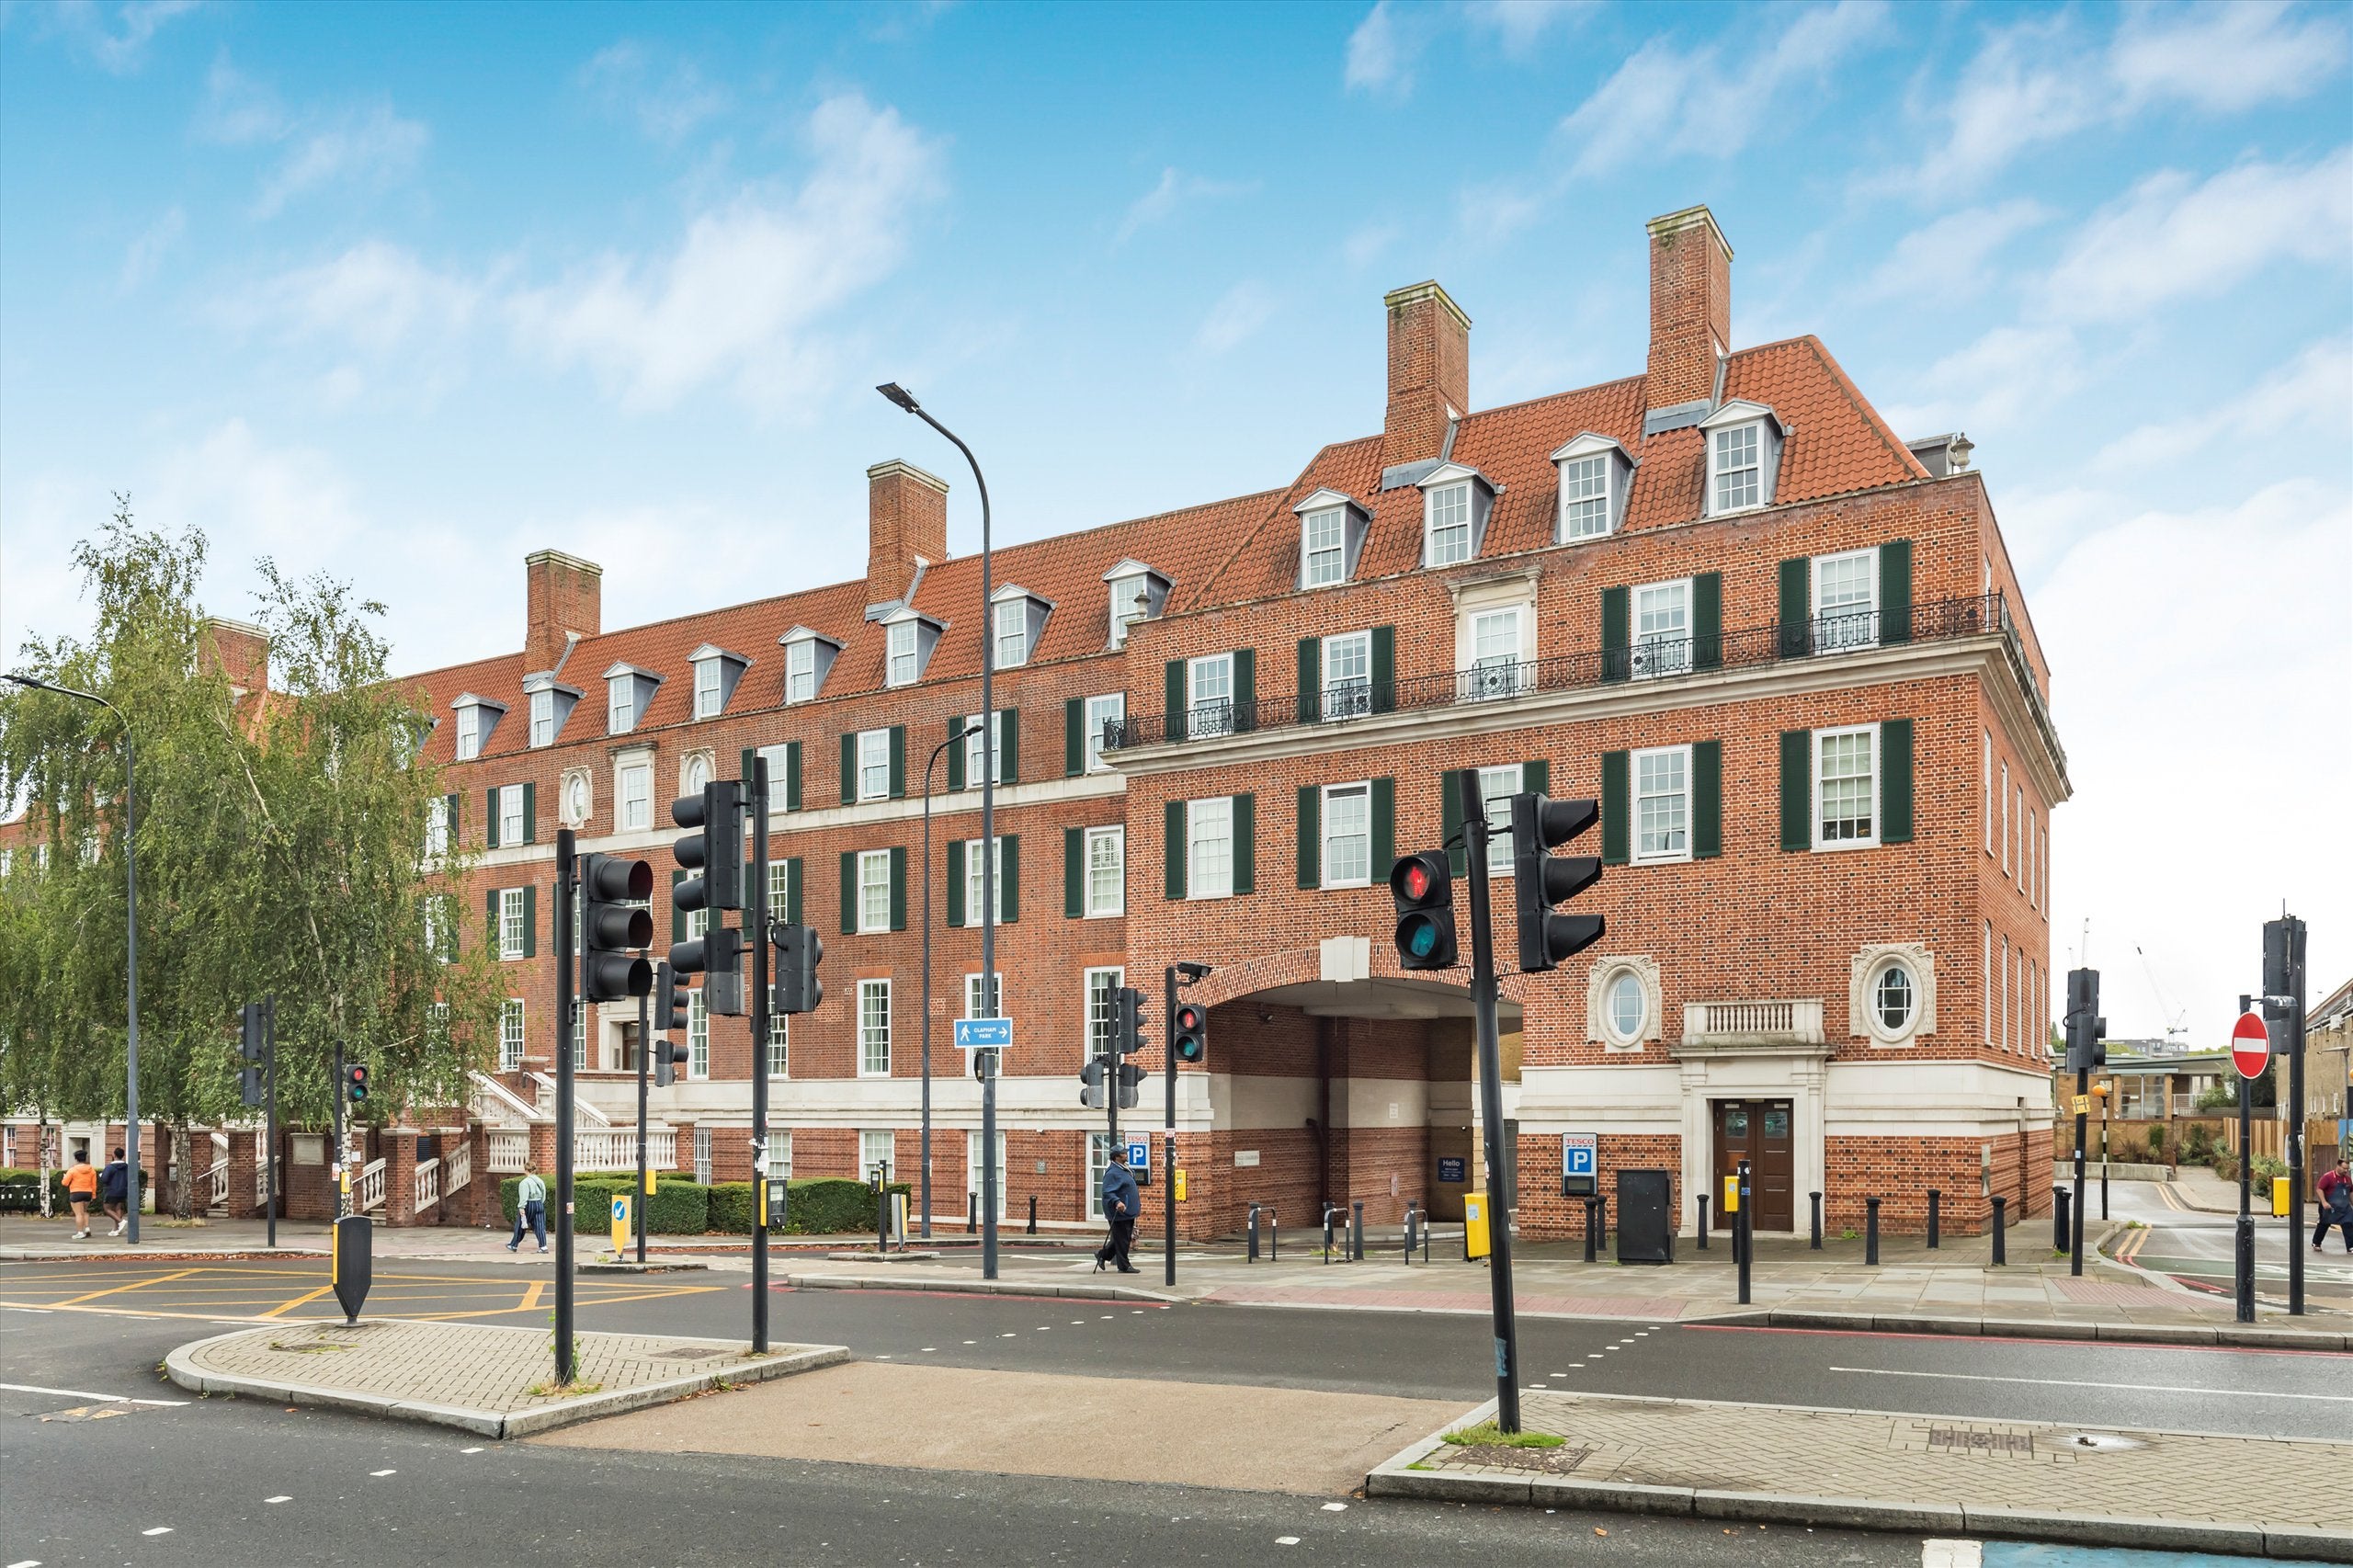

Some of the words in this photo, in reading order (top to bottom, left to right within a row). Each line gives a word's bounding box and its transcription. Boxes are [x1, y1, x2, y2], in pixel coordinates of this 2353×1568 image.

[1132, 1147, 1144, 1164] P
[1442, 1159, 1461, 1167] Hello
[1574, 1151, 1588, 1171] P
